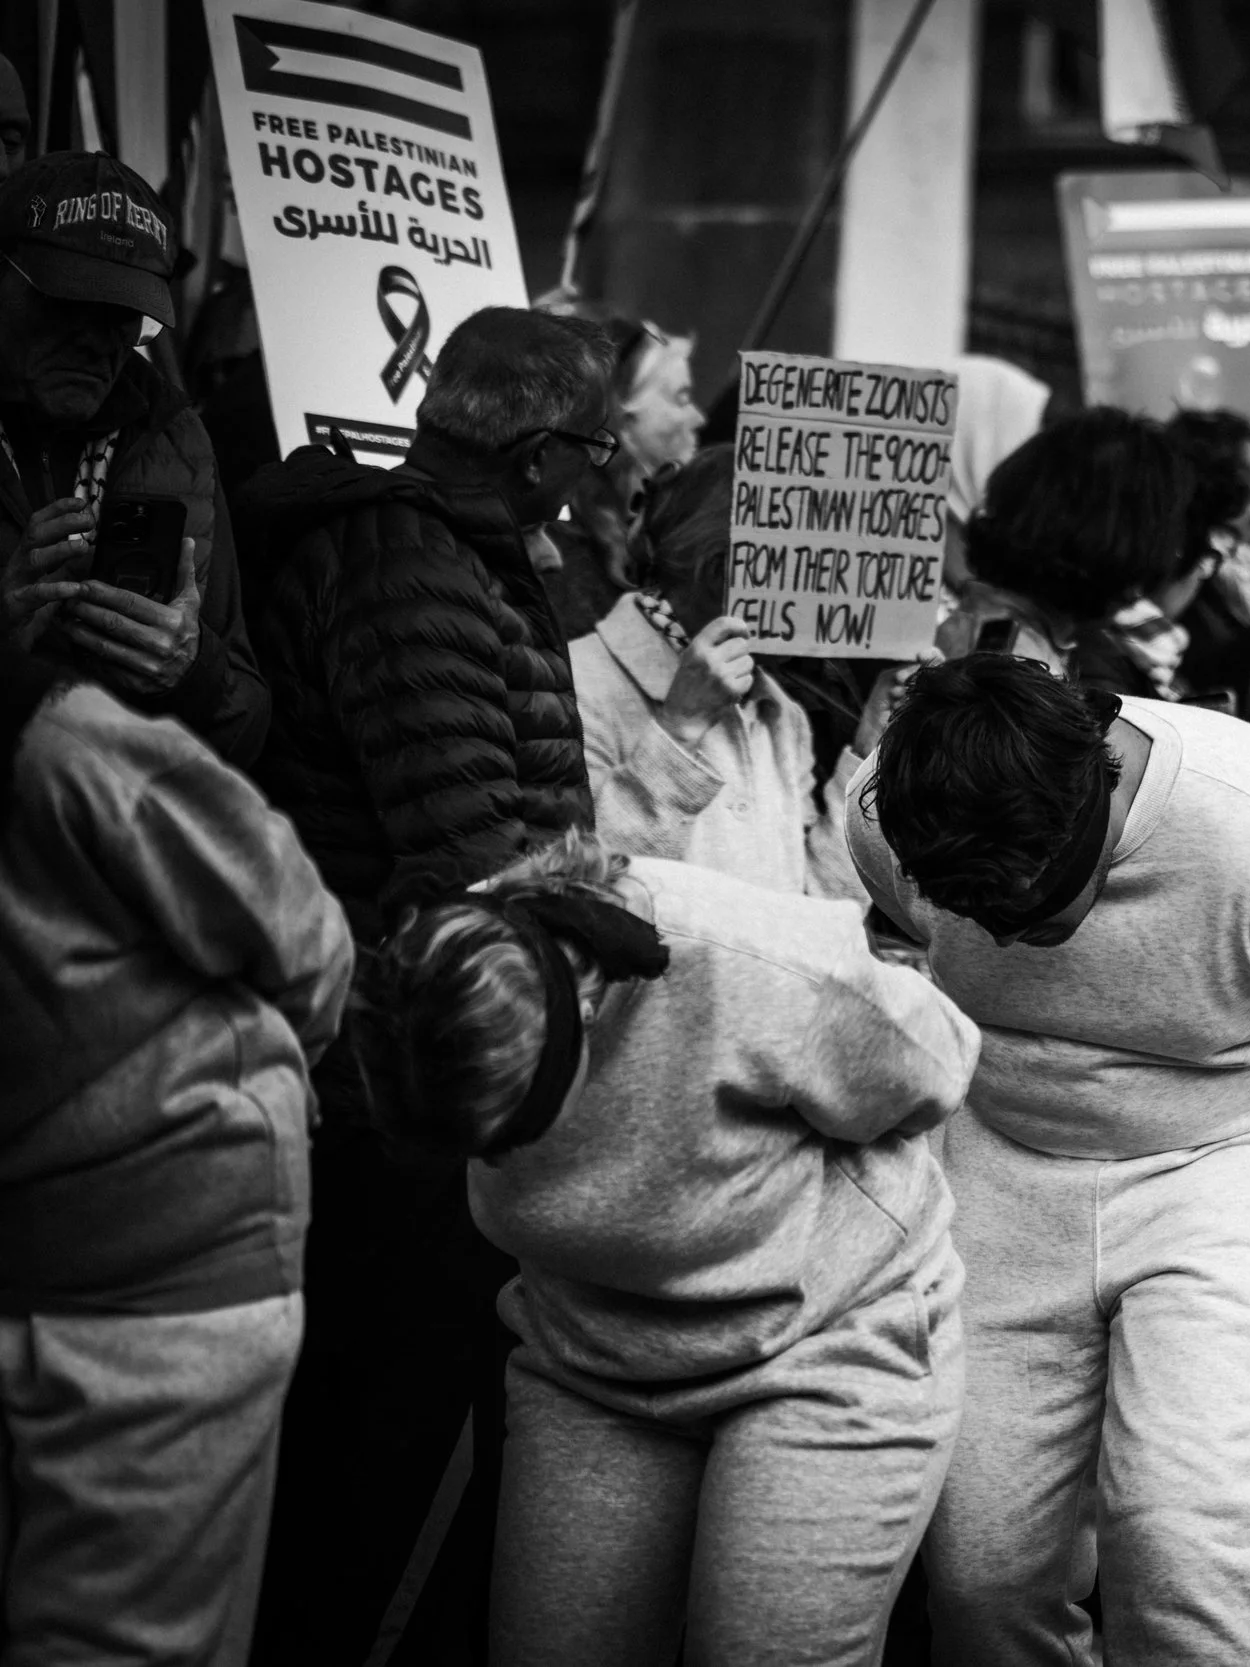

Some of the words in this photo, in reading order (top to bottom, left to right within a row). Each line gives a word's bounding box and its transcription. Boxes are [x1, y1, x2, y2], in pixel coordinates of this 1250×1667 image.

[252, 111, 319, 141] FREE
[327, 124, 478, 178] PALESTINIAN
[257, 142, 484, 220] HOSTAGES
[53, 194, 97, 231] RING
[101, 192, 122, 221] OF
[126, 193, 167, 250] KERRY
[100, 231, 135, 247] Ireland
[272, 200, 399, 245] للأسرى
[407, 217, 492, 270] الحرية
[865, 374, 956, 426] ZIONISTS
[737, 426, 831, 477] RELEASE
[843, 432, 885, 481] THE
[736, 481, 856, 532] PALESTINIAN
[859, 489, 946, 543] HOSTAGES
[730, 540, 787, 592] FROM
[793, 546, 849, 595] THEIR
[856, 552, 939, 602] TORTURE
[815, 603, 876, 649] NOW!
